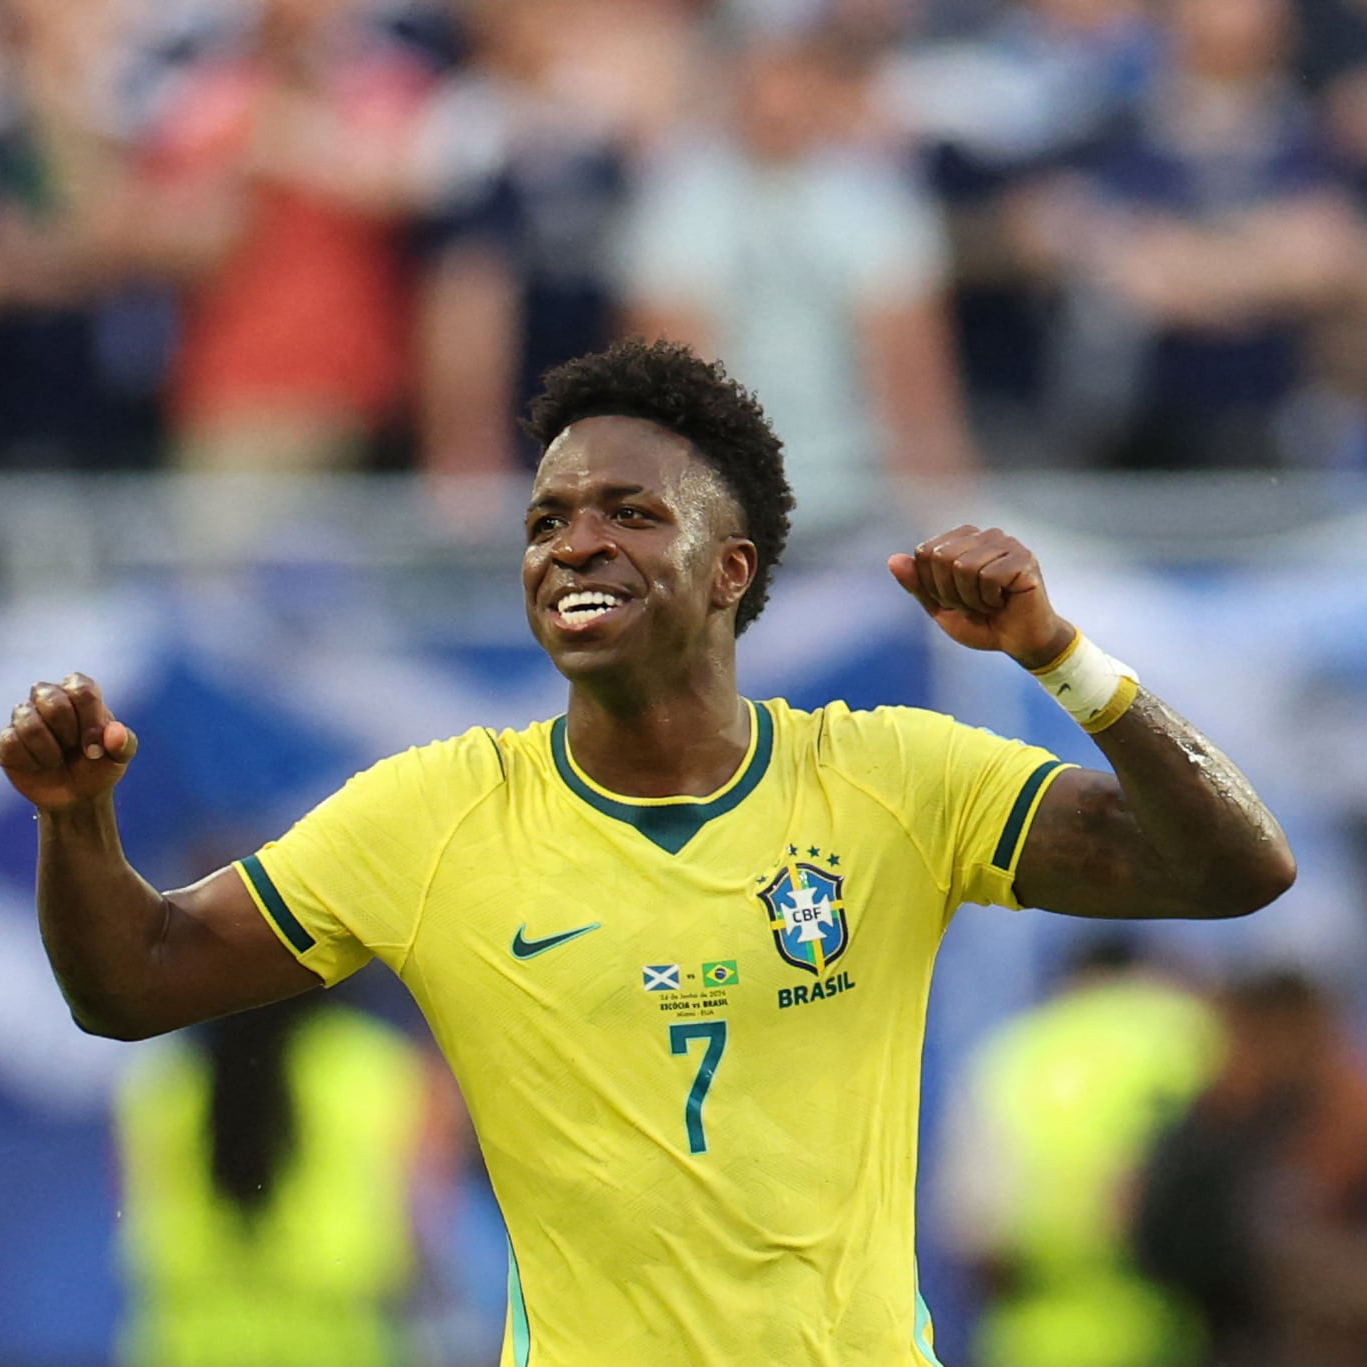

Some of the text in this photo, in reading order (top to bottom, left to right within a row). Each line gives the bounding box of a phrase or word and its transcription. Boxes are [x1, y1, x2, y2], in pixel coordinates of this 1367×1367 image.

[792, 907, 821, 923] CBF
[778, 971, 855, 1009] BRASIL
[660, 1001, 690, 1010] ESCÓCIA
[703, 998, 728, 1008] BRASIL
[668, 1020, 727, 1155] 7
